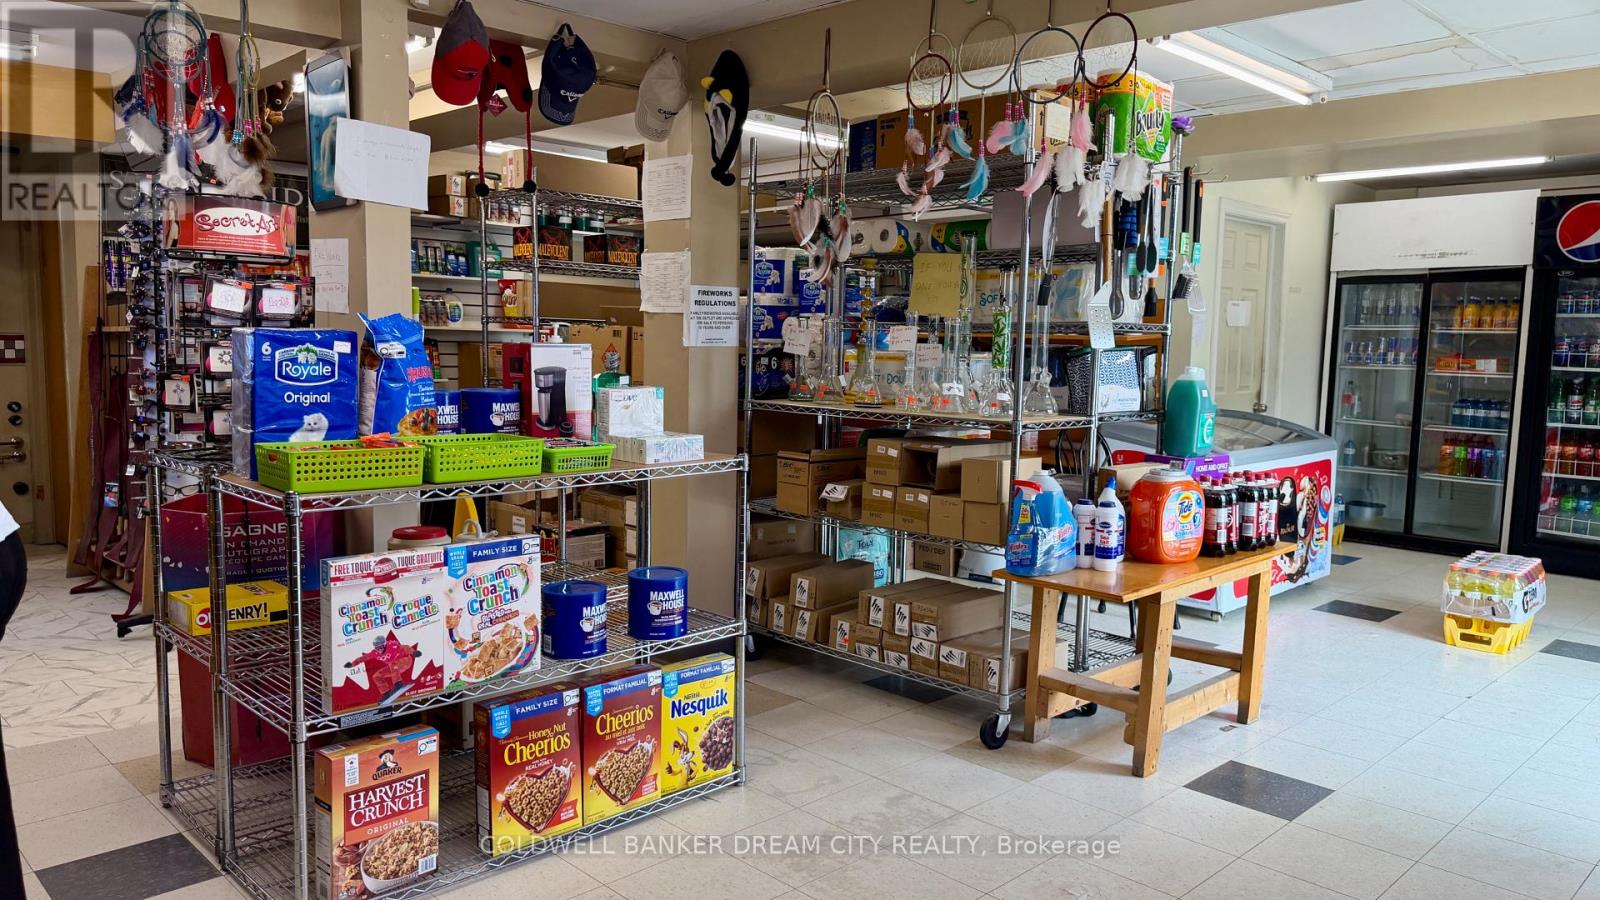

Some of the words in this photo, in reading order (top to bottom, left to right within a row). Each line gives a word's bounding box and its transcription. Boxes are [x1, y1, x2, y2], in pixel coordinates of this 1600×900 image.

[194, 212, 255, 232] Secret
[255, 214, 280, 233] Art
[697, 289, 733, 297] FIREWORKS
[980, 292, 999, 306] SOF
[694, 299, 736, 307] REGULATIONS
[261, 341, 272, 355] 6
[282, 361, 332, 380] Royale
[771, 356, 777, 369] 6
[886, 373, 905, 384] DOU
[284, 391, 331, 407] Original
[437, 405, 459, 415] XWELL
[504, 412, 520, 421] HOUS
[437, 414, 459, 425] HOUSE
[1178, 500, 1193, 516] Tide
[397, 557, 416, 567] TUQUE
[416, 551, 442, 564] GRATUITE
[473, 546, 500, 558] FAMILY
[501, 544, 518, 553] SIZE
[334, 563, 350, 575] FREE
[351, 560, 372, 573] TOQUE
[464, 567, 518, 590] Cinnamon
[475, 580, 510, 599] Toast
[650, 589, 684, 601] MAXWELL
[340, 598, 387, 616] Cinnamon
[394, 595, 432, 615] Croque
[469, 585, 519, 615] Crunch
[662, 598, 684, 610] HOUSE
[226, 602, 269, 621] ENRY!
[350, 608, 379, 622] Toast
[393, 605, 438, 628] Cannelle
[583, 602, 607, 618] MAXW
[343, 615, 387, 636] Crunch
[680, 669, 699, 679] FORMAT
[699, 664, 721, 676] FAMILIAL
[603, 684, 624, 695] FORMAT
[624, 678, 647, 690] FAMILIAL
[515, 703, 541, 715] FAMILY
[543, 698, 558, 708] SIZE
[671, 688, 728, 719] Nesquik
[596, 705, 654, 736] Cheerios
[528, 728, 552, 741] Honey
[553, 722, 566, 734] Nut
[503, 733, 571, 766] Cheerios
[372, 766, 402, 781] QUAKER
[348, 774, 426, 812] HARVEST
[350, 790, 425, 827] CRUNCH
[367, 817, 409, 835] ORIGINAL
